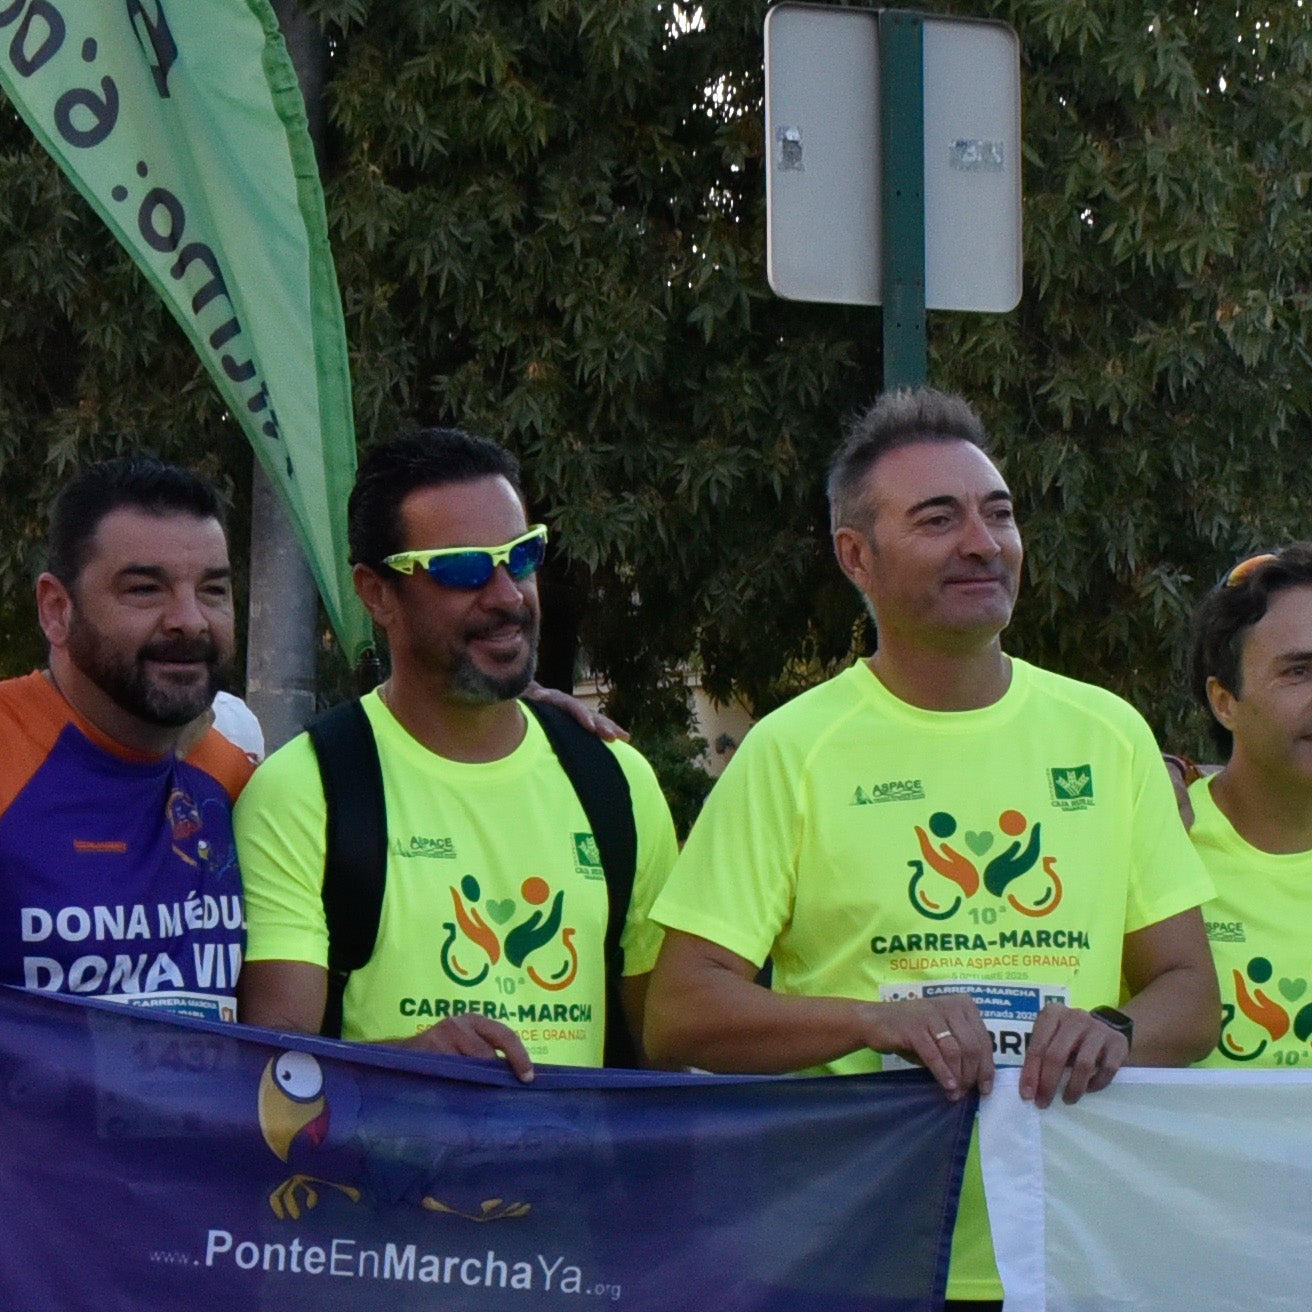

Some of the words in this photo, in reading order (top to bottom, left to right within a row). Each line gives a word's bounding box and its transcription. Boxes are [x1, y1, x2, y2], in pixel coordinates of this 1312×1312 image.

[21, 904, 151, 942] DONA
[1205, 922, 1243, 932] SPACE
[871, 930, 1090, 954] CARRERA-MARCHA
[23, 951, 184, 992] DONA
[890, 957, 963, 970] SOLIDARIA
[967, 955, 1018, 970] ASPACE
[926, 986, 1036, 997] CARRERA-MARCHA
[399, 998, 592, 1023] CARRERA-MARCHA
